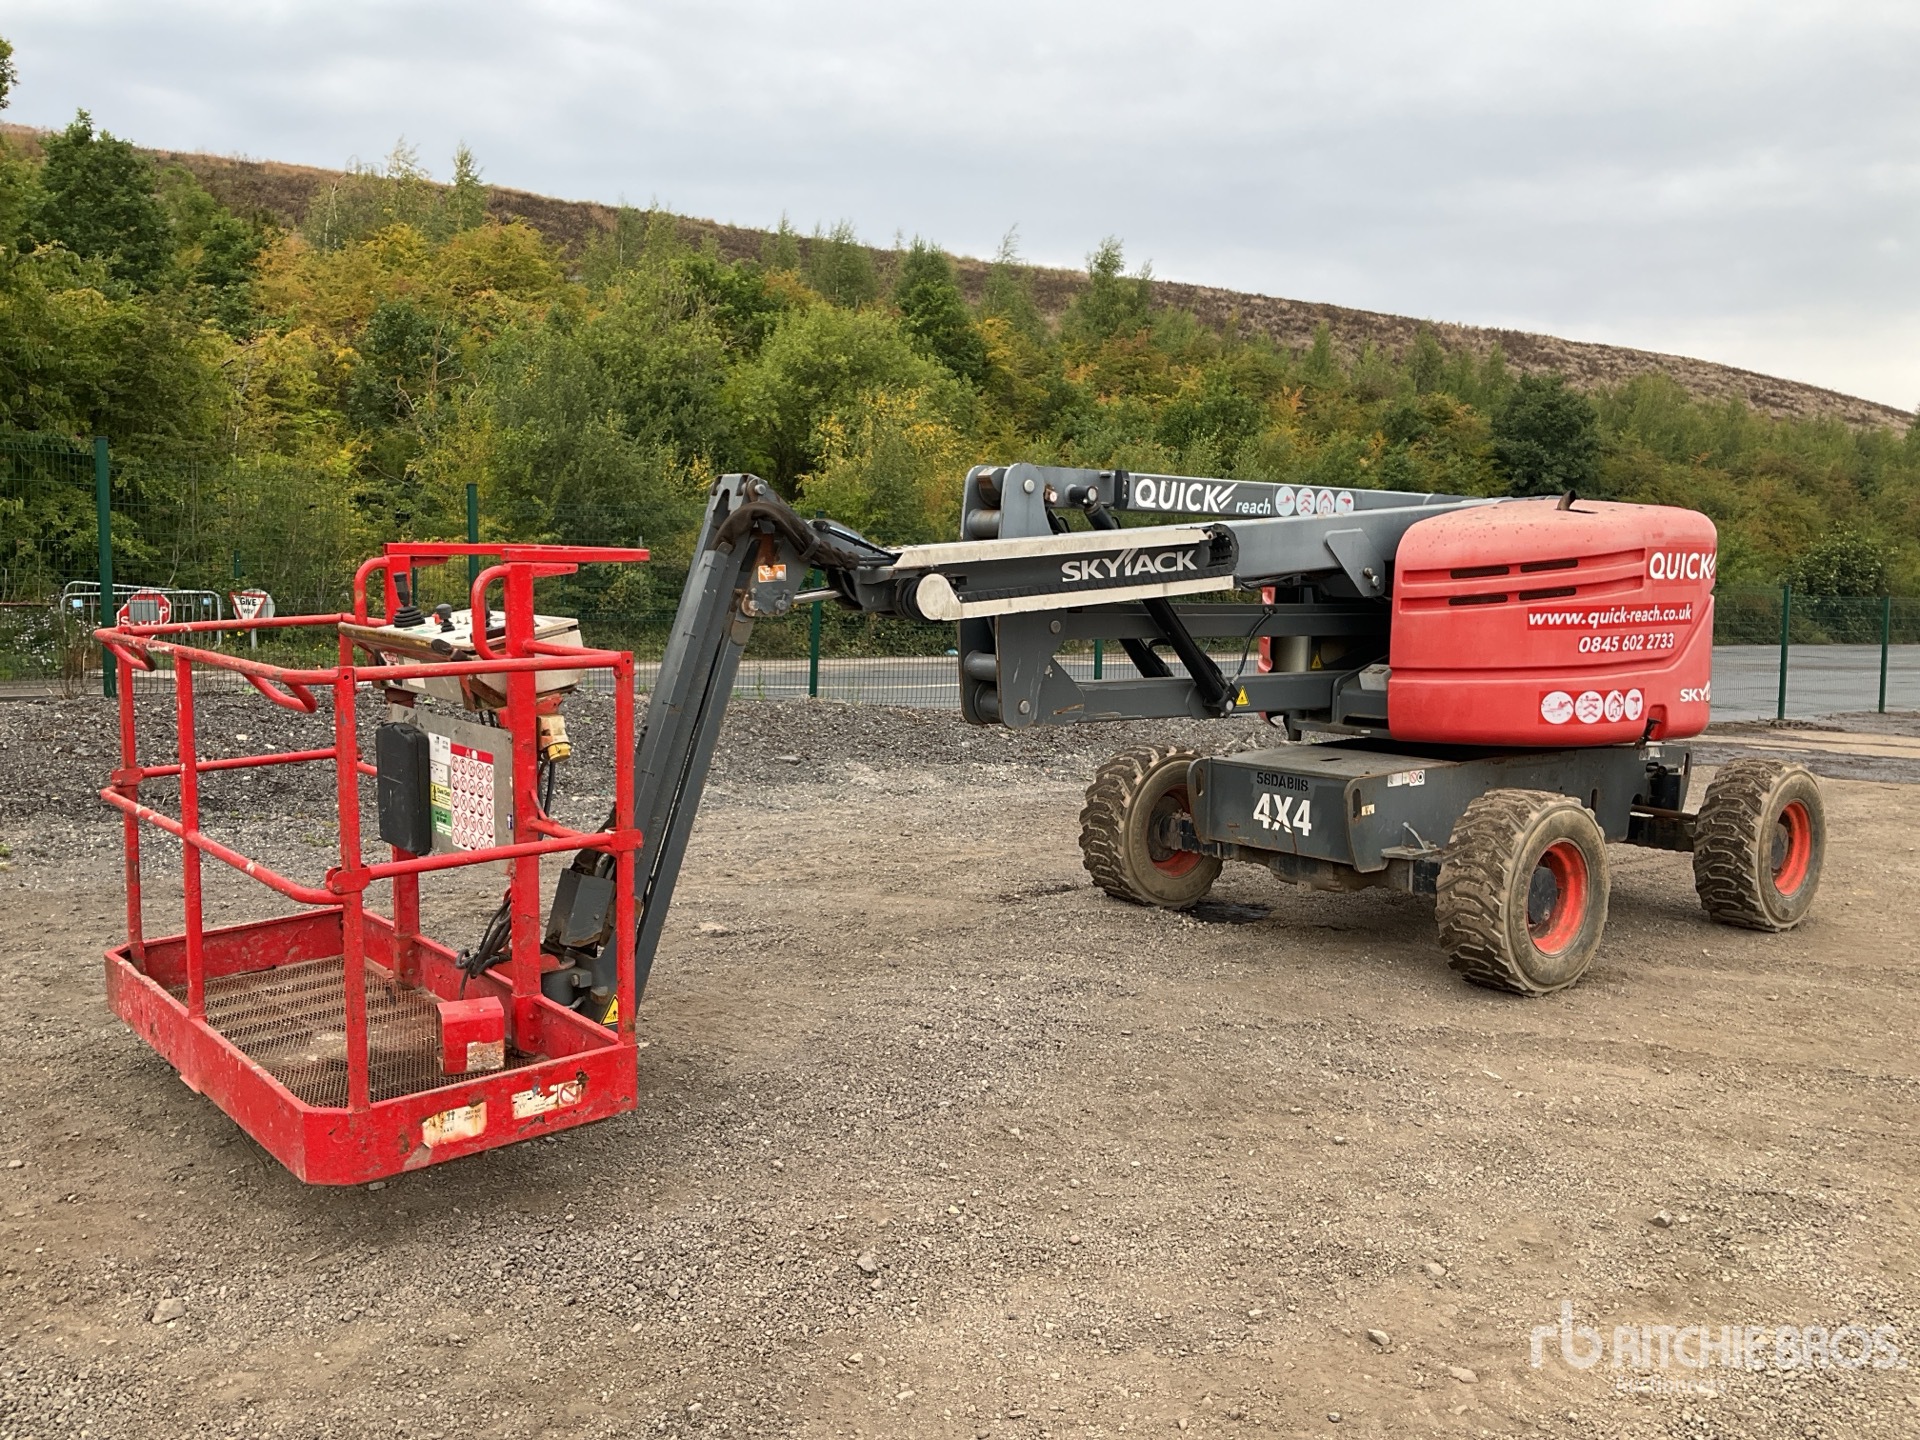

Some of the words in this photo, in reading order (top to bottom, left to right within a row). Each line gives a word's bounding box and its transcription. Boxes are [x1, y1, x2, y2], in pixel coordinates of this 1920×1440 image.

[1135, 479, 1220, 512] QUICK
[1236, 497, 1271, 515] reach
[1061, 548, 1198, 582] SKYJACK
[1649, 552, 1711, 580] QUICK
[240, 597, 257, 607] GIVE
[1528, 604, 1692, 629] www.quick-reach.co.uk
[1578, 636, 1619, 653] 0845
[1622, 634, 1644, 651] 602
[1647, 632, 1675, 649] 2733
[1253, 792, 1312, 837] 4X4
